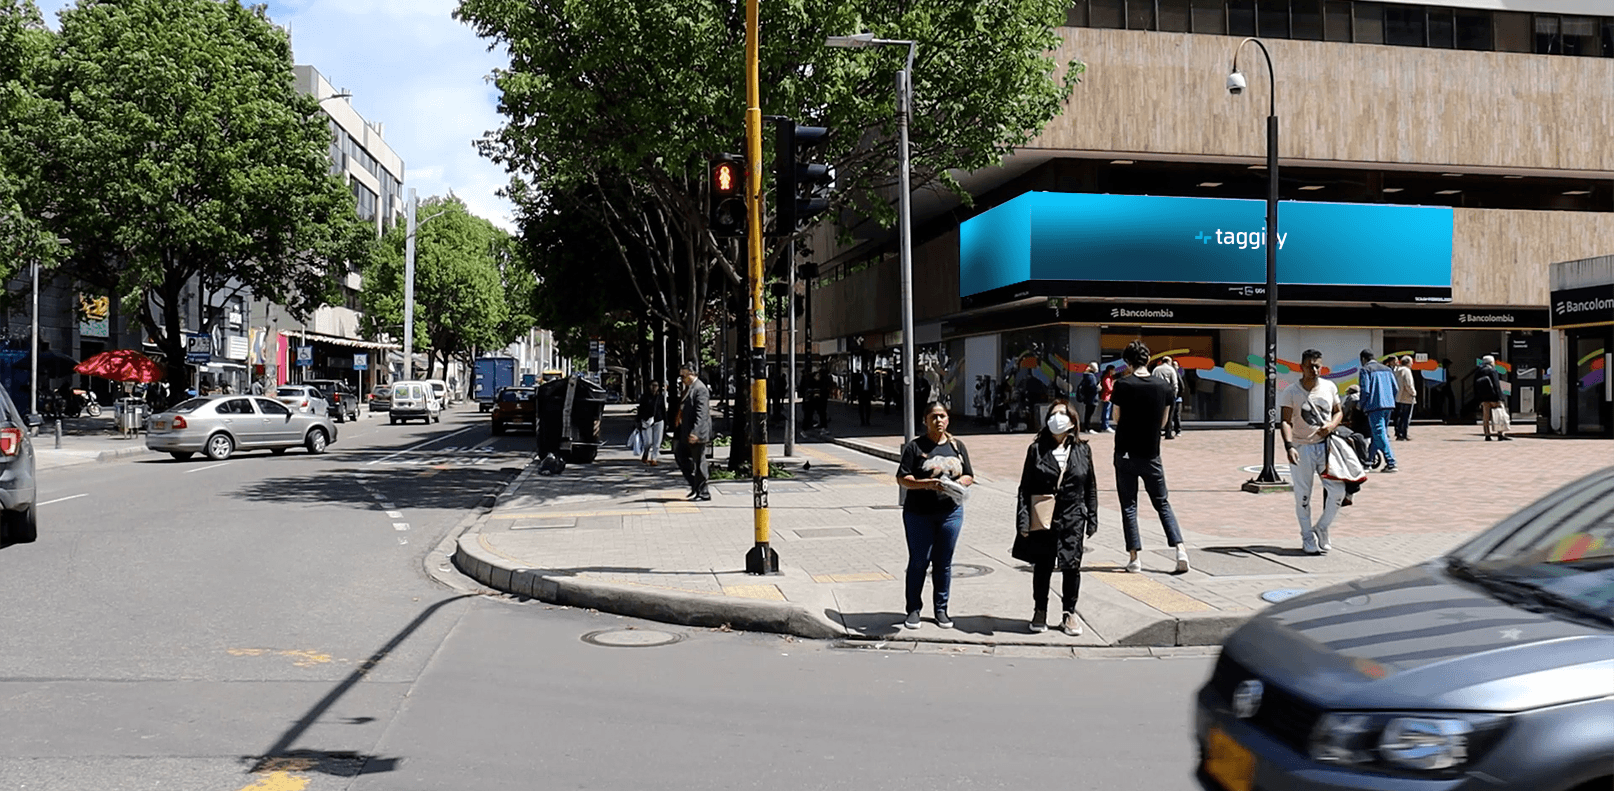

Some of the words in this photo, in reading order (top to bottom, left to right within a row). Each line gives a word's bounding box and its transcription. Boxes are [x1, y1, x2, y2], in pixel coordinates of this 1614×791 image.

[1215, 226, 1288, 250] taggiy
[1120, 308, 1174, 318] Bancolombia
[1466, 313, 1515, 323] Bancolombia
[188, 338, 196, 352] P
